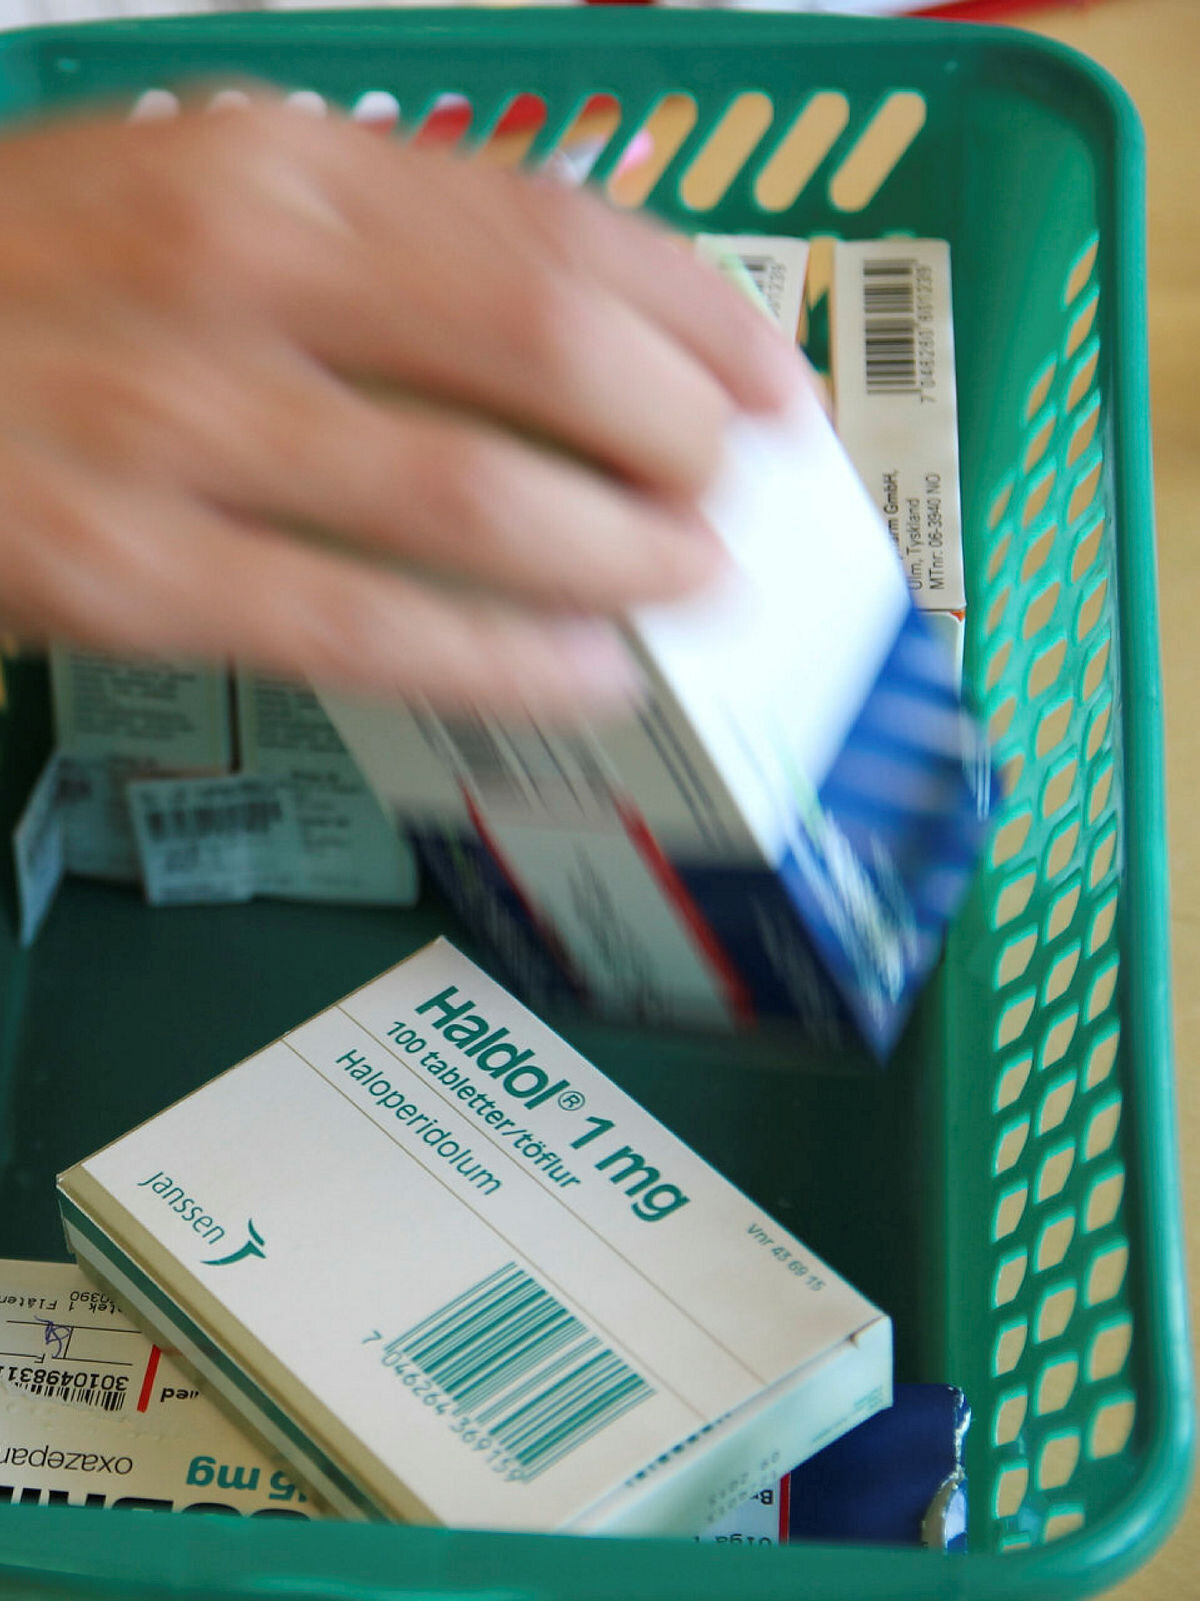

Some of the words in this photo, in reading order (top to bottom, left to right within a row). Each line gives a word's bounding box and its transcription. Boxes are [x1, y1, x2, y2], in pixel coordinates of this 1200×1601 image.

[906, 497, 924, 556] Tyskland
[335, 1049, 504, 1196] Haloperidolum
[386, 1021, 428, 1055] 100
[420, 1050, 582, 1189] tabletter/töflur
[569, 1115, 617, 1150] 1
[594, 1145, 692, 1223] mg
[747, 1223, 775, 1246] Vnr
[89, 1302, 123, 1315] tek
[361, 1330, 383, 1345] 7
[381, 1351, 451, 1416] 046264
[448, 1417, 526, 1482] 369159
[186, 1455, 260, 1490] mg
